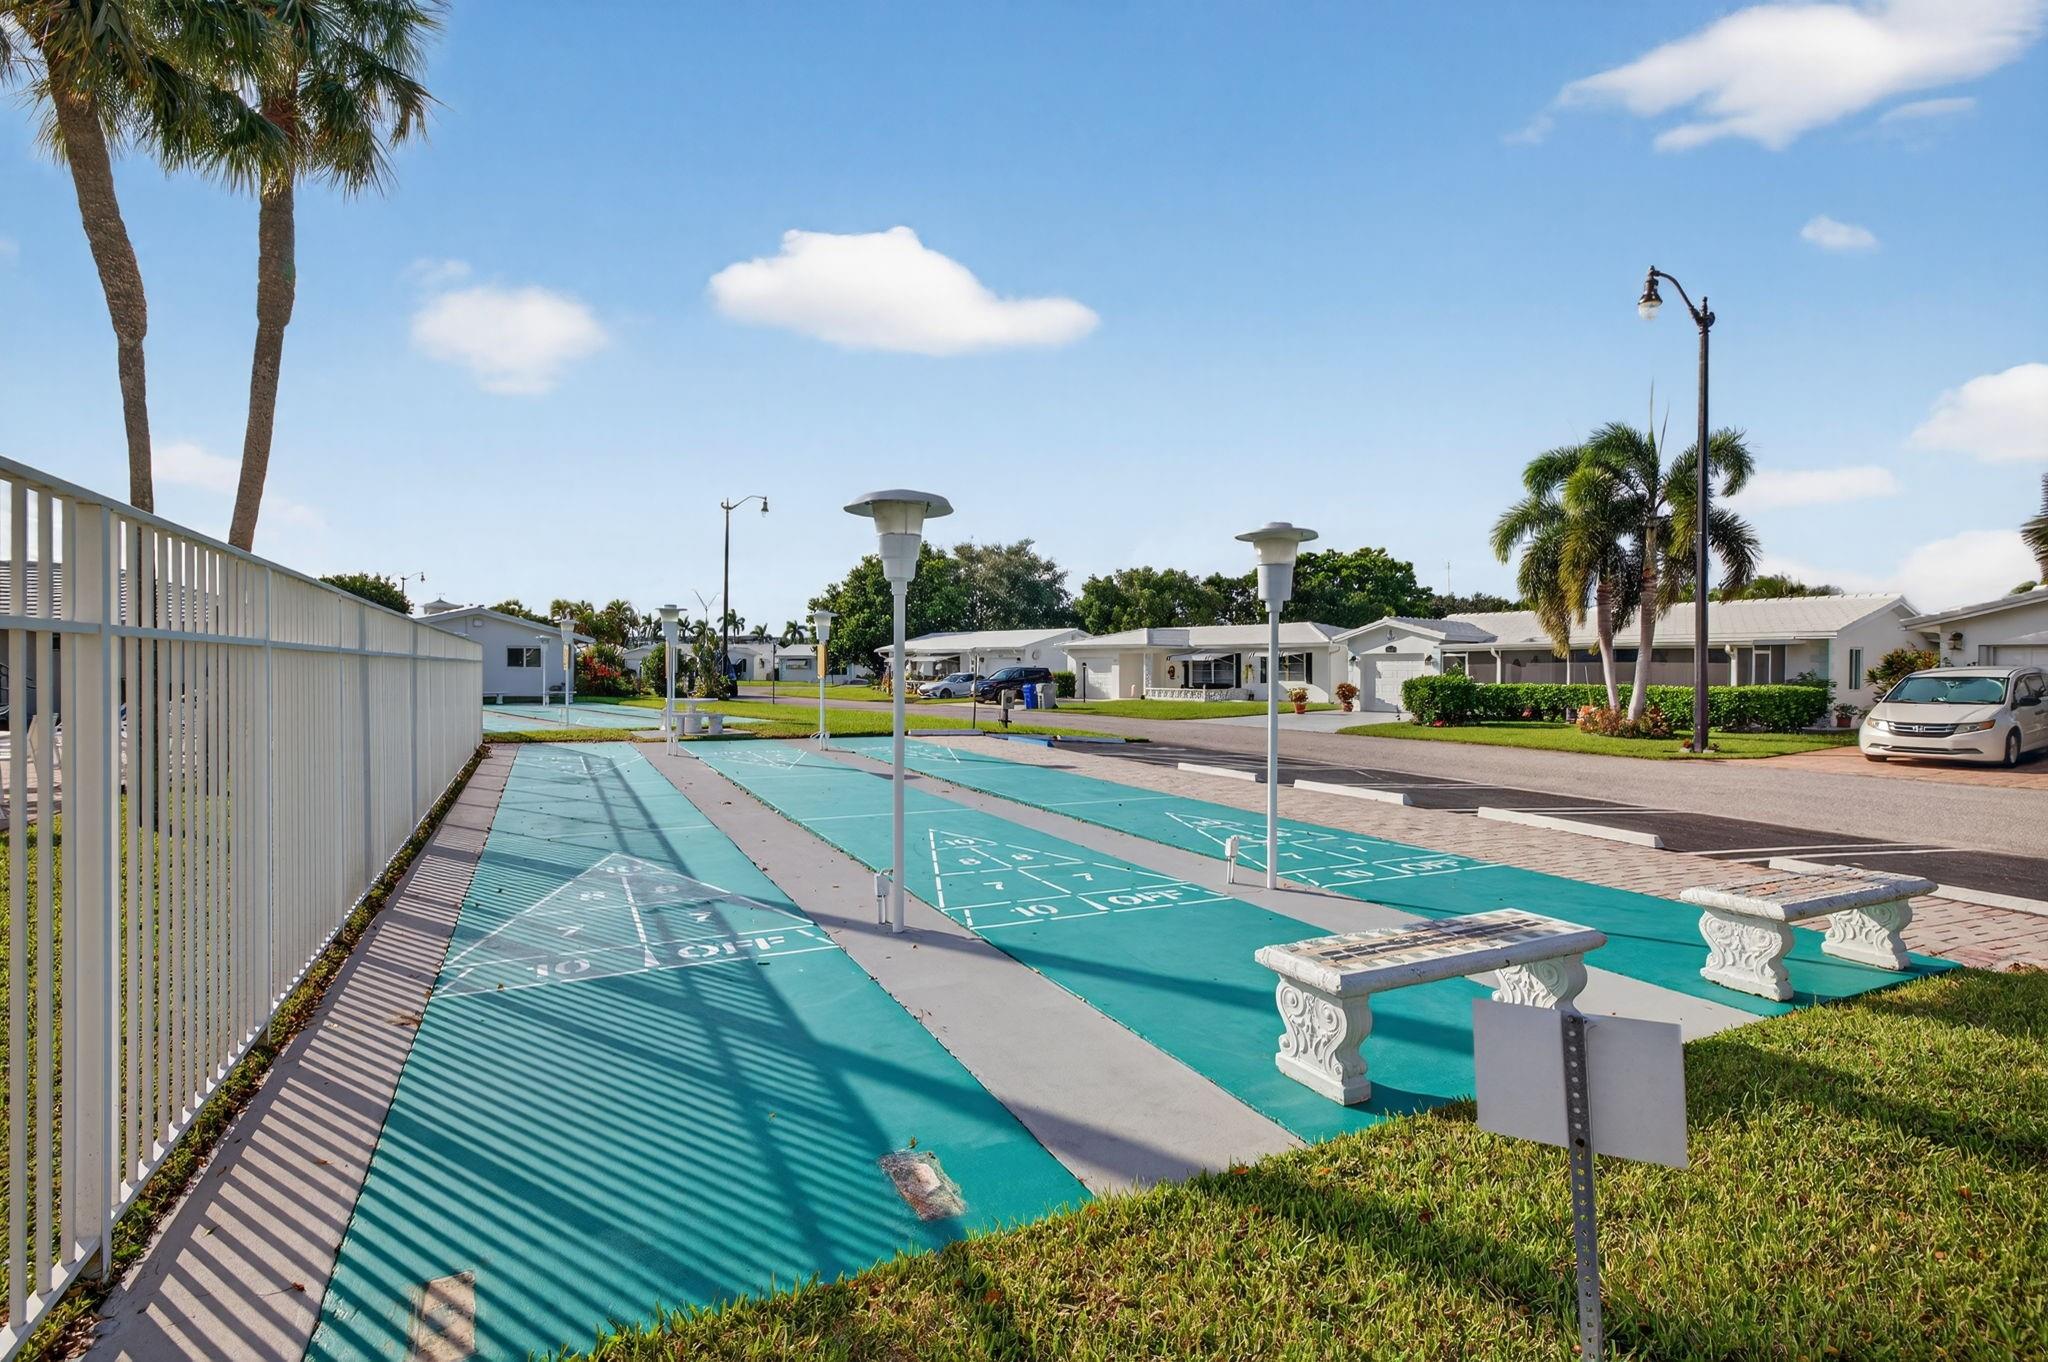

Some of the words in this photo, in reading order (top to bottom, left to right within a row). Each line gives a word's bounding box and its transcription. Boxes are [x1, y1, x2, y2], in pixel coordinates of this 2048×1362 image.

[1333, 869, 1375, 879] 10
[1400, 859, 1459, 871] OFF
[1010, 904, 1059, 917] 10
[1107, 889, 1184, 905] OFF
[526, 958, 591, 978] 10
[678, 935, 785, 958] OFF
